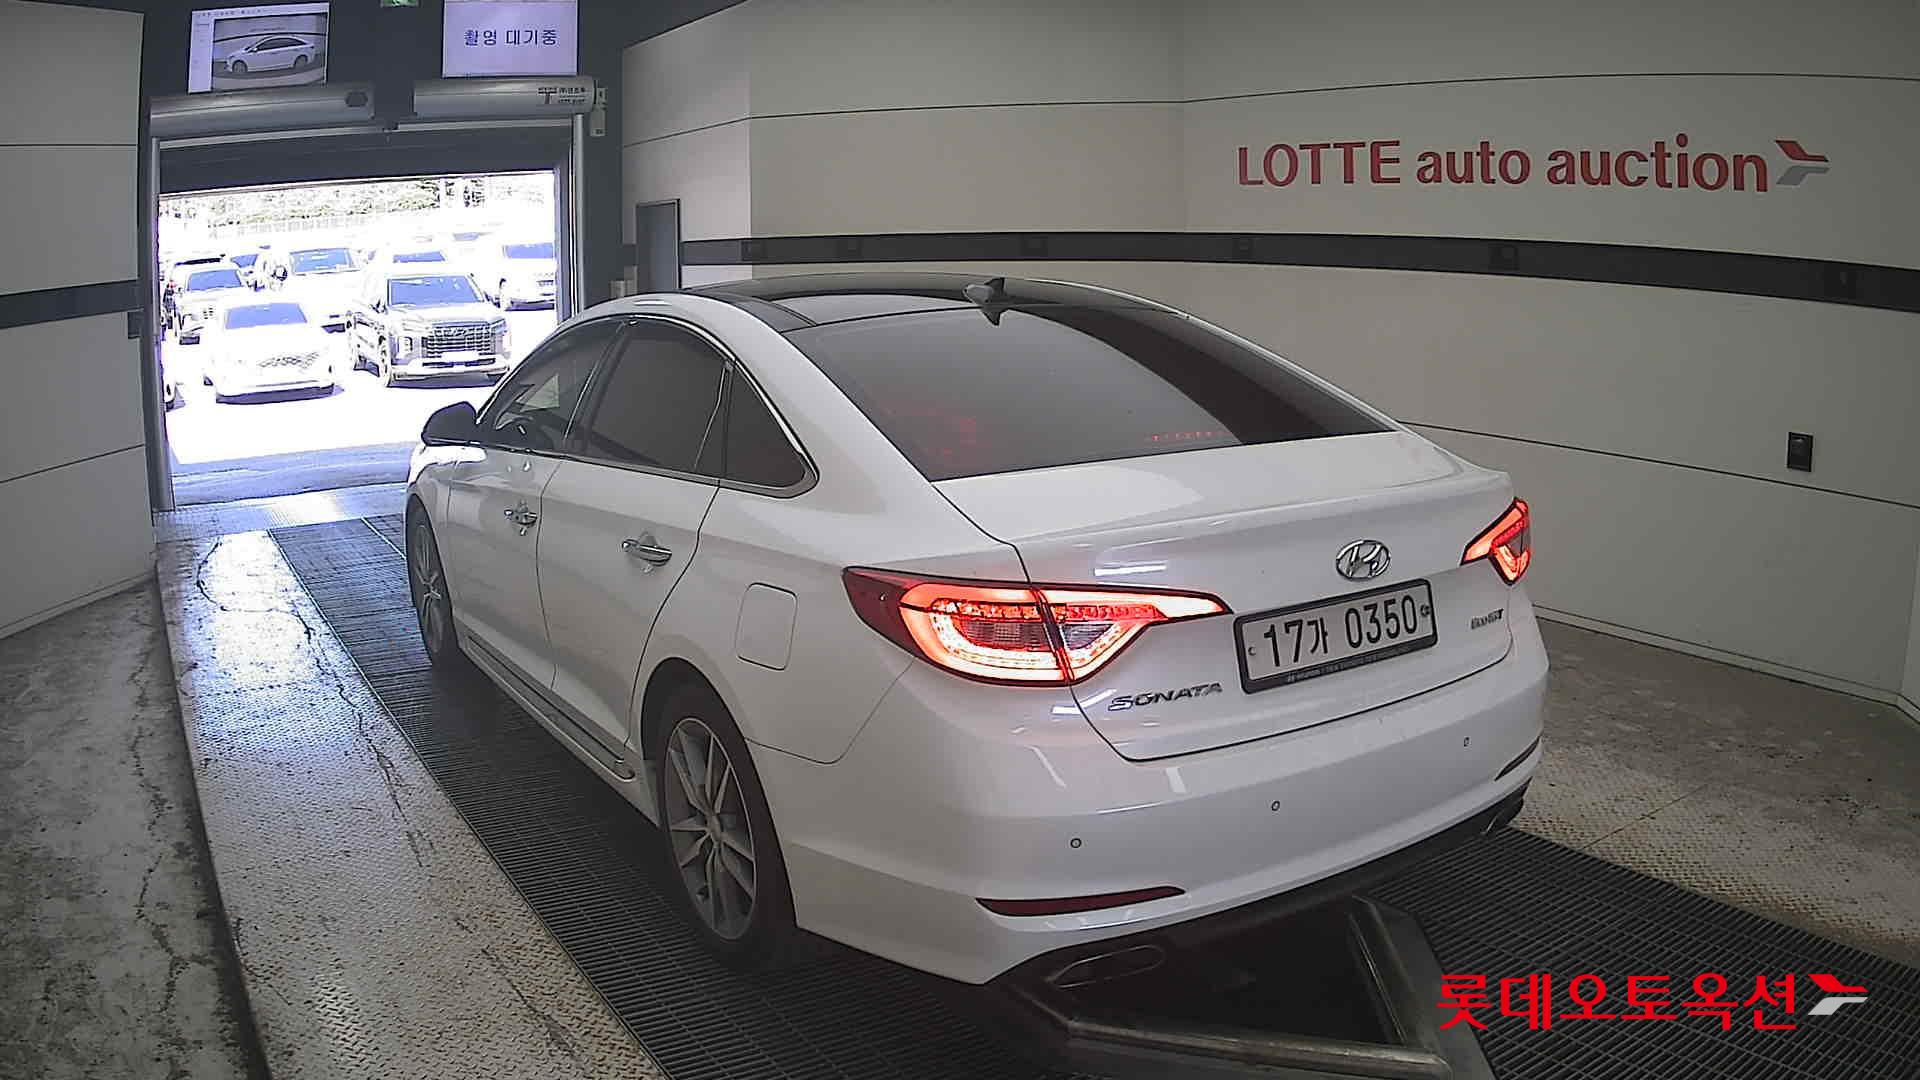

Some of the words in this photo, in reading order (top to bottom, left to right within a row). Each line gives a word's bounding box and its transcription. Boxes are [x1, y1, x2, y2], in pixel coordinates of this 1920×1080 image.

[505, 29, 558, 46] 대기중
[1238, 141, 1400, 187] LOTTE
[1416, 140, 1531, 186] auto
[1546, 133, 1768, 193] auction
[1263, 617, 1329, 667] 17가
[1345, 594, 1418, 649] 0350
[1108, 682, 1223, 712] SONATA
